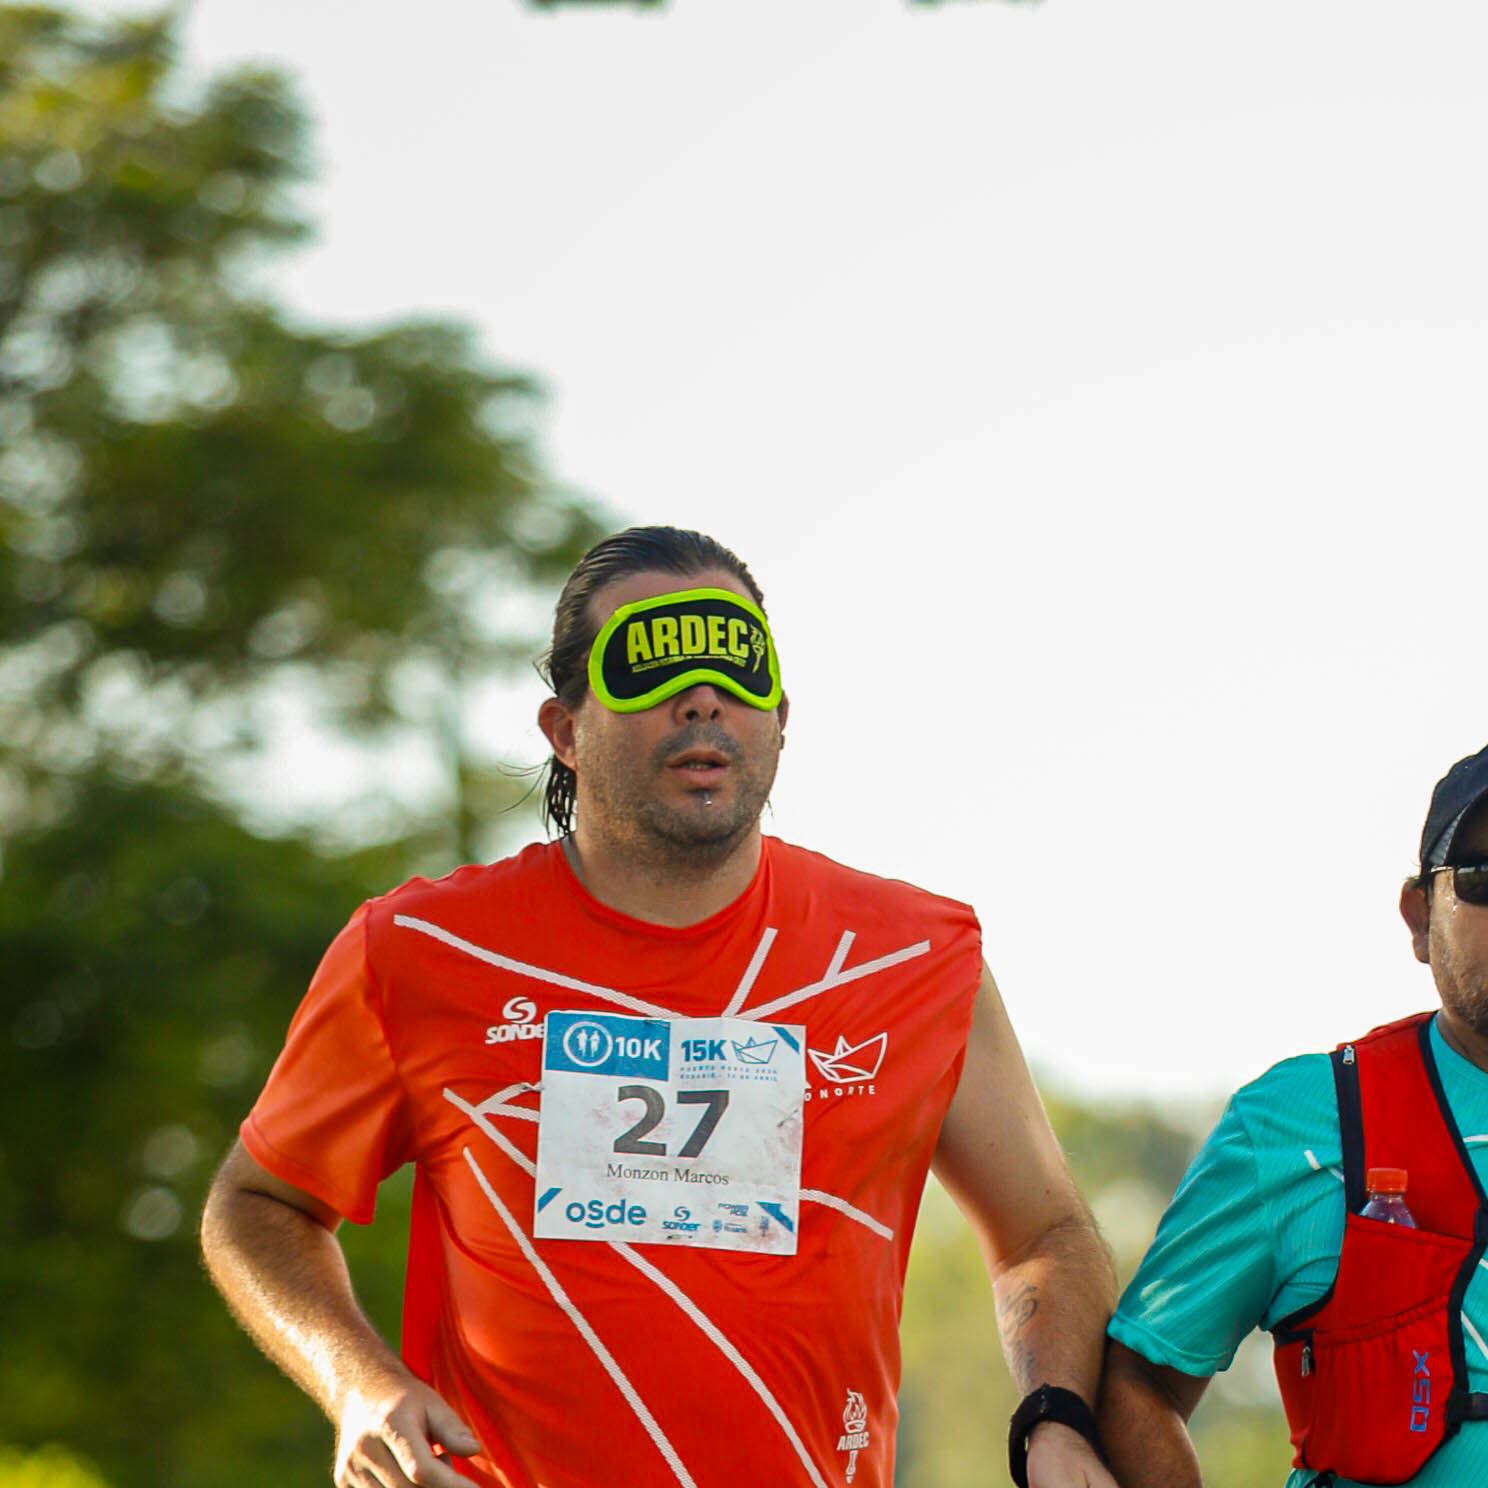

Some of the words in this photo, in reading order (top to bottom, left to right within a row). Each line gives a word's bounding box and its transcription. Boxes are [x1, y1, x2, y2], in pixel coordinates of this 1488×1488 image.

[627, 615, 748, 664] ARDEC
[485, 1023, 545, 1045] SONDE
[615, 1036, 662, 1061] 10K
[681, 1039, 727, 1062] 15K
[819, 1084, 875, 1099] NORTE
[613, 1085, 730, 1158] 27
[606, 1163, 668, 1181] Monzon
[674, 1167, 729, 1186] Marcos
[566, 1199, 647, 1228] osde
[837, 1432, 869, 1451] ARDEC
